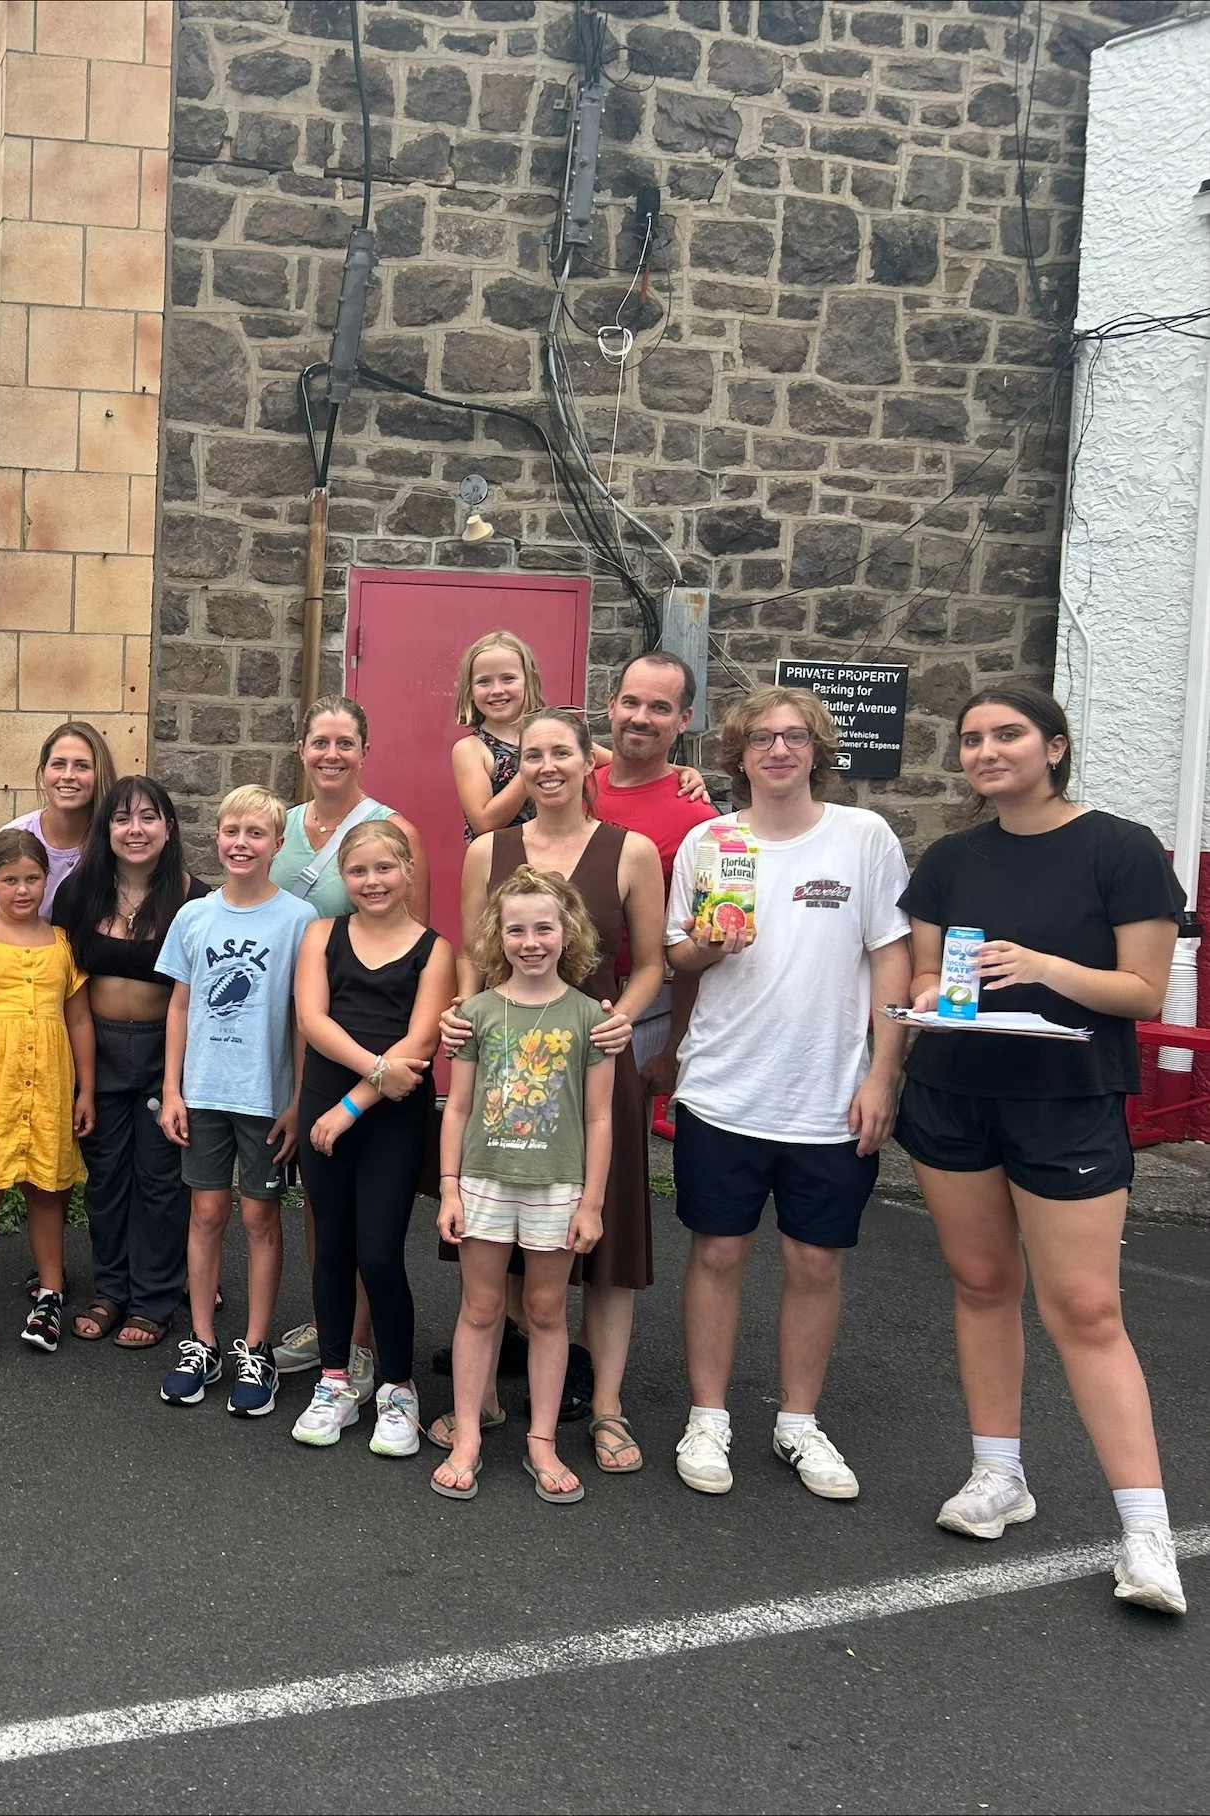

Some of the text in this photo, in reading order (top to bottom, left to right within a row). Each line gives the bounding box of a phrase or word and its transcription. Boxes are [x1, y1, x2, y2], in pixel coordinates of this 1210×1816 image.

[786, 667, 900, 683] PRIVATE PROPERTY
[812, 683, 873, 698] Parking for
[821, 700, 897, 714] Butler Avenue
[849, 731, 880, 740] Vehicles
[839, 740, 900, 750] Owner's Expense
[721, 857, 756, 870] Florida's
[720, 867, 755, 879] Natural
